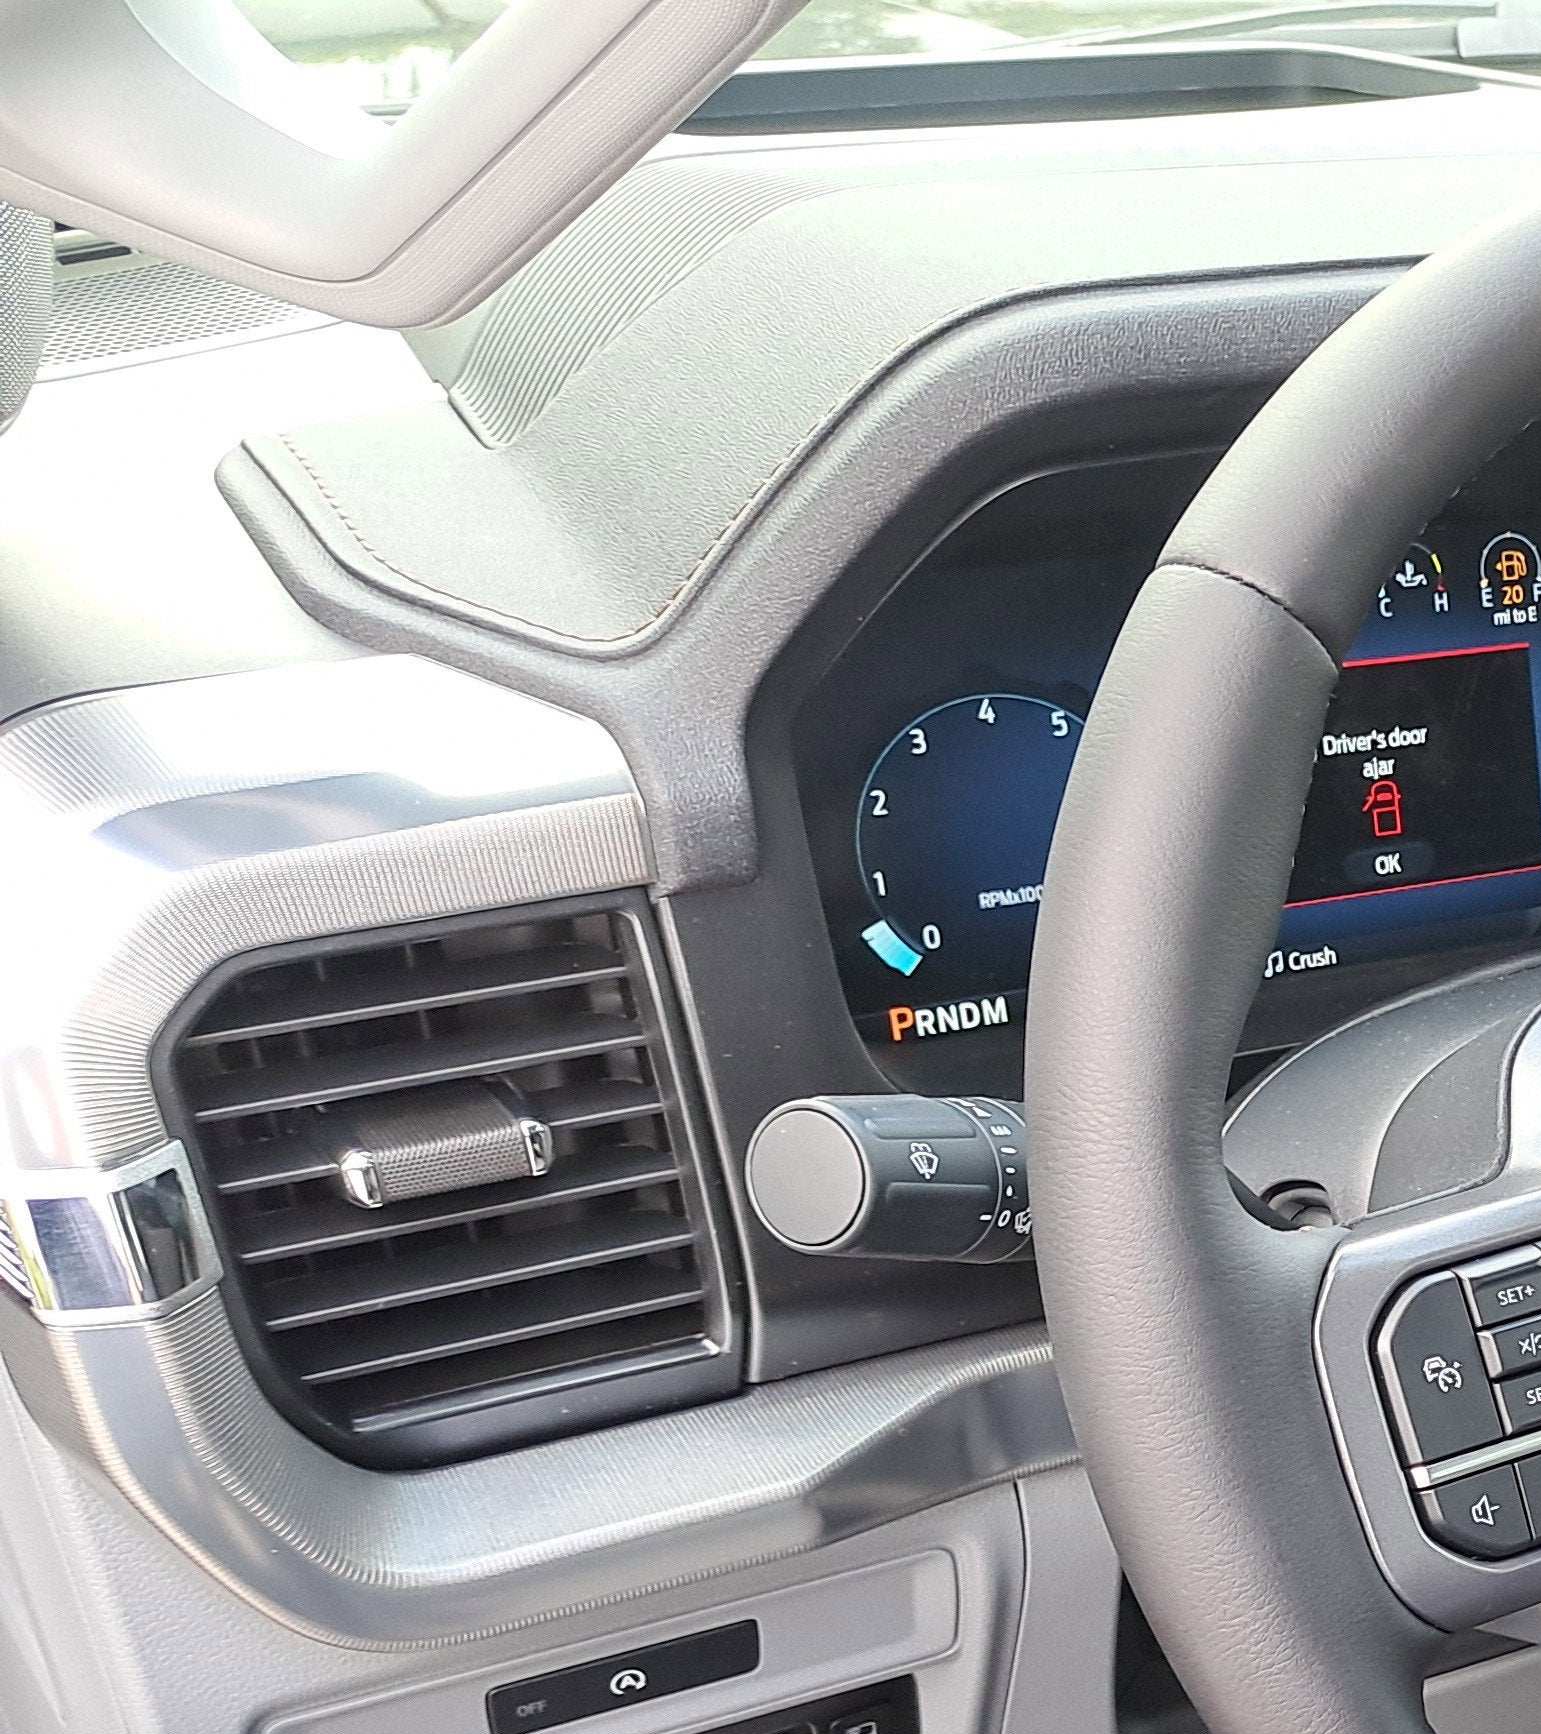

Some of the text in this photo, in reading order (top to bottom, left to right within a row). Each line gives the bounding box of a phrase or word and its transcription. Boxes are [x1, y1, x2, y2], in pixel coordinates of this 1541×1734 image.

[1378, 596, 1393, 619] C
[1433, 592, 1450, 613] H
[1481, 587, 1494, 607] E
[1501, 585, 1523, 604] 20
[1493, 605, 1537, 625] mi to E
[978, 699, 995, 725] 4
[1050, 711, 1068, 738] 5
[909, 729, 928, 755] 3
[1322, 724, 1427, 756] Driver's door
[1363, 757, 1395, 779] ajar
[869, 790, 889, 817] 2
[1375, 853, 1401, 874] OK
[873, 871, 886, 897] 1
[922, 925, 941, 950] 0
[1288, 946, 1337, 971] Crush
[1497, 1285, 1536, 1306] SET+
[516, 1699, 547, 1717] OFF
